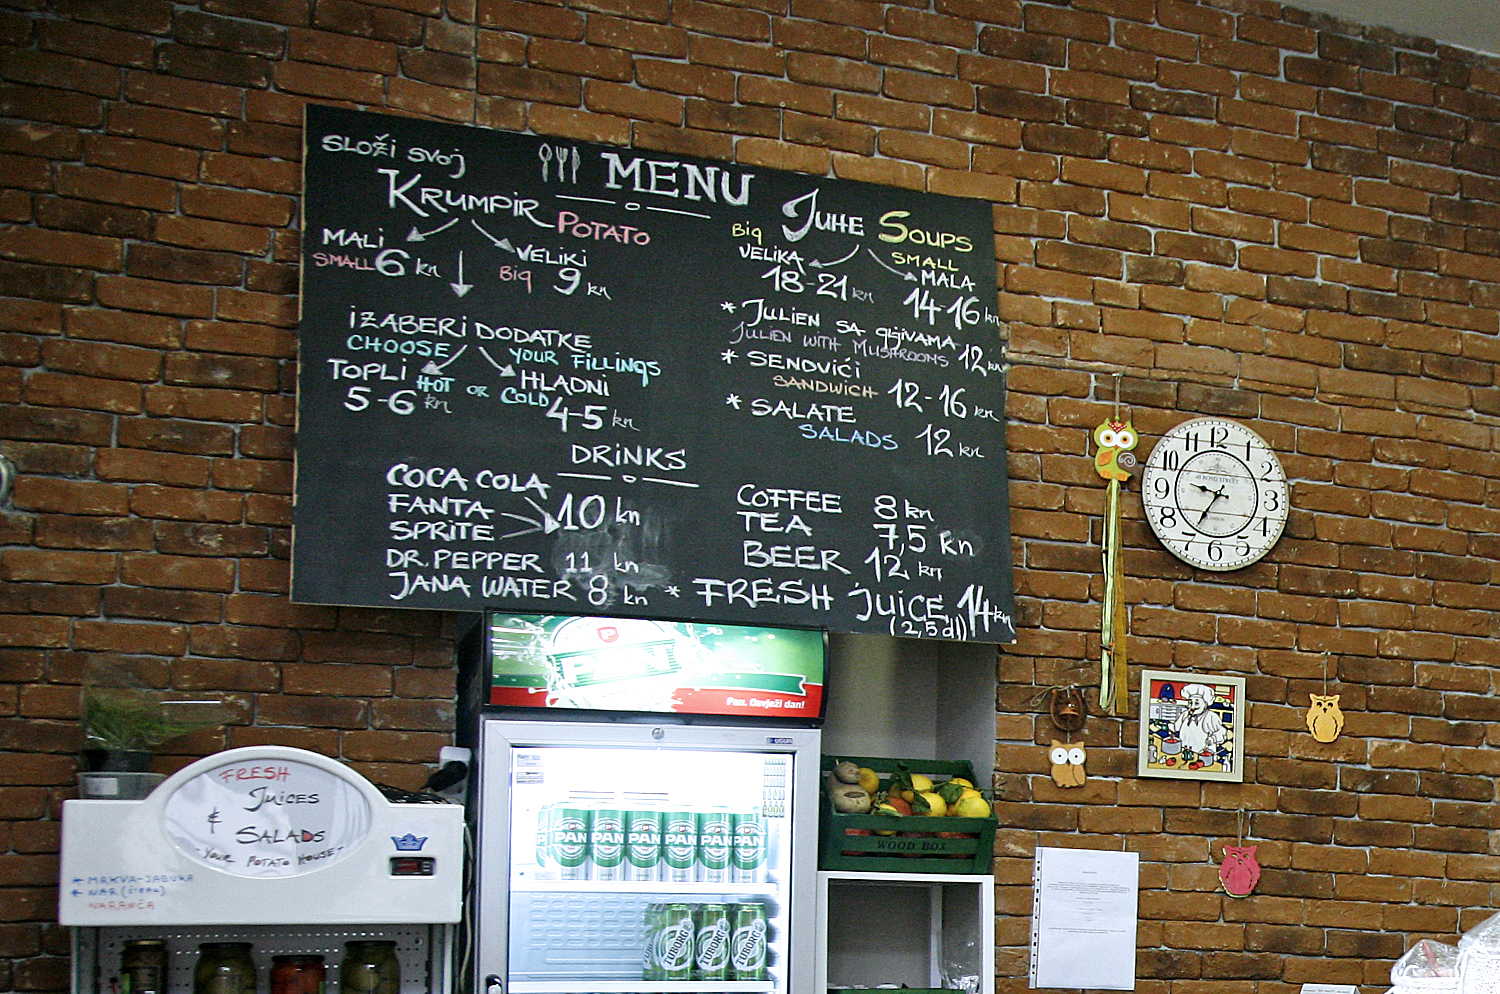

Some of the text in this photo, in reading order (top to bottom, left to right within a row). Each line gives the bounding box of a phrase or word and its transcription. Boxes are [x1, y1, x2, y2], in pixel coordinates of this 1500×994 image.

[601, 152, 756, 207] MENU
[377, 168, 555, 228] KRUMPIR
[557, 211, 651, 246] POTATO
[781, 187, 974, 253] JUHE SOUPS
[312, 252, 376, 272] SMALL
[375, 249, 441, 279] 6 kn
[891, 251, 960, 272] SMALL
[553, 267, 612, 300] 9 kn
[920, 268, 976, 292] MALA
[741, 298, 822, 328] JULIEN
[836, 319, 865, 337] SA
[475, 321, 593, 350] DODATKE
[347, 334, 451, 359] CHOOSE
[509, 347, 559, 366] YOUR
[803, 330, 842, 351] WITH
[852, 339, 950, 368] MUSHROOMS
[958, 343, 988, 377] 12
[416, 374, 550, 408] HOT OR COLD
[773, 375, 878, 398] SANDWICH
[343, 386, 417, 416] 5-6
[751, 398, 857, 423] SALATE
[545, 396, 641, 433] 4-5 kn
[799, 423, 899, 450] SALADS
[915, 423, 985, 459] 12 kn
[1185, 432, 1199, 452] 11
[1210, 427, 1230, 449] 12
[571, 443, 686, 471] DRINKS
[1163, 450, 1179, 471] 10
[1246, 440, 1251, 462] 1
[386, 463, 552, 499] COCA COLA
[1260, 461, 1273, 482] 2
[1154, 478, 1170, 499] 9
[1264, 490, 1279, 511] 3
[387, 493, 495, 519] FANTA
[558, 493, 641, 531] 10 kn
[737, 483, 935, 522] COFFEE 8 kn
[388, 520, 495, 541] SPRITE
[1160, 507, 1177, 528] 8
[1252, 517, 1271, 537] 4
[737, 511, 813, 536] TEA
[940, 530, 975, 557] kn
[1181, 531, 1197, 551] 7
[1235, 535, 1250, 557] 5
[565, 552, 594, 575] 11
[613, 552, 640, 574] kn
[743, 540, 944, 584] BEER 12 kn
[1207, 540, 1223, 562] 6
[388, 571, 648, 606] JANA WATER 8 kn
[692, 578, 835, 612] FRESH
[957, 584, 992, 637] 14
[219, 767, 291, 784] FRESH
[235, 826, 326, 845] SALADS
[555, 832, 587, 844] PAN
[877, 840, 947, 852] WOOD BOX
[247, 855, 290, 868] POTATO
[663, 929, 690, 966] TUBORG
